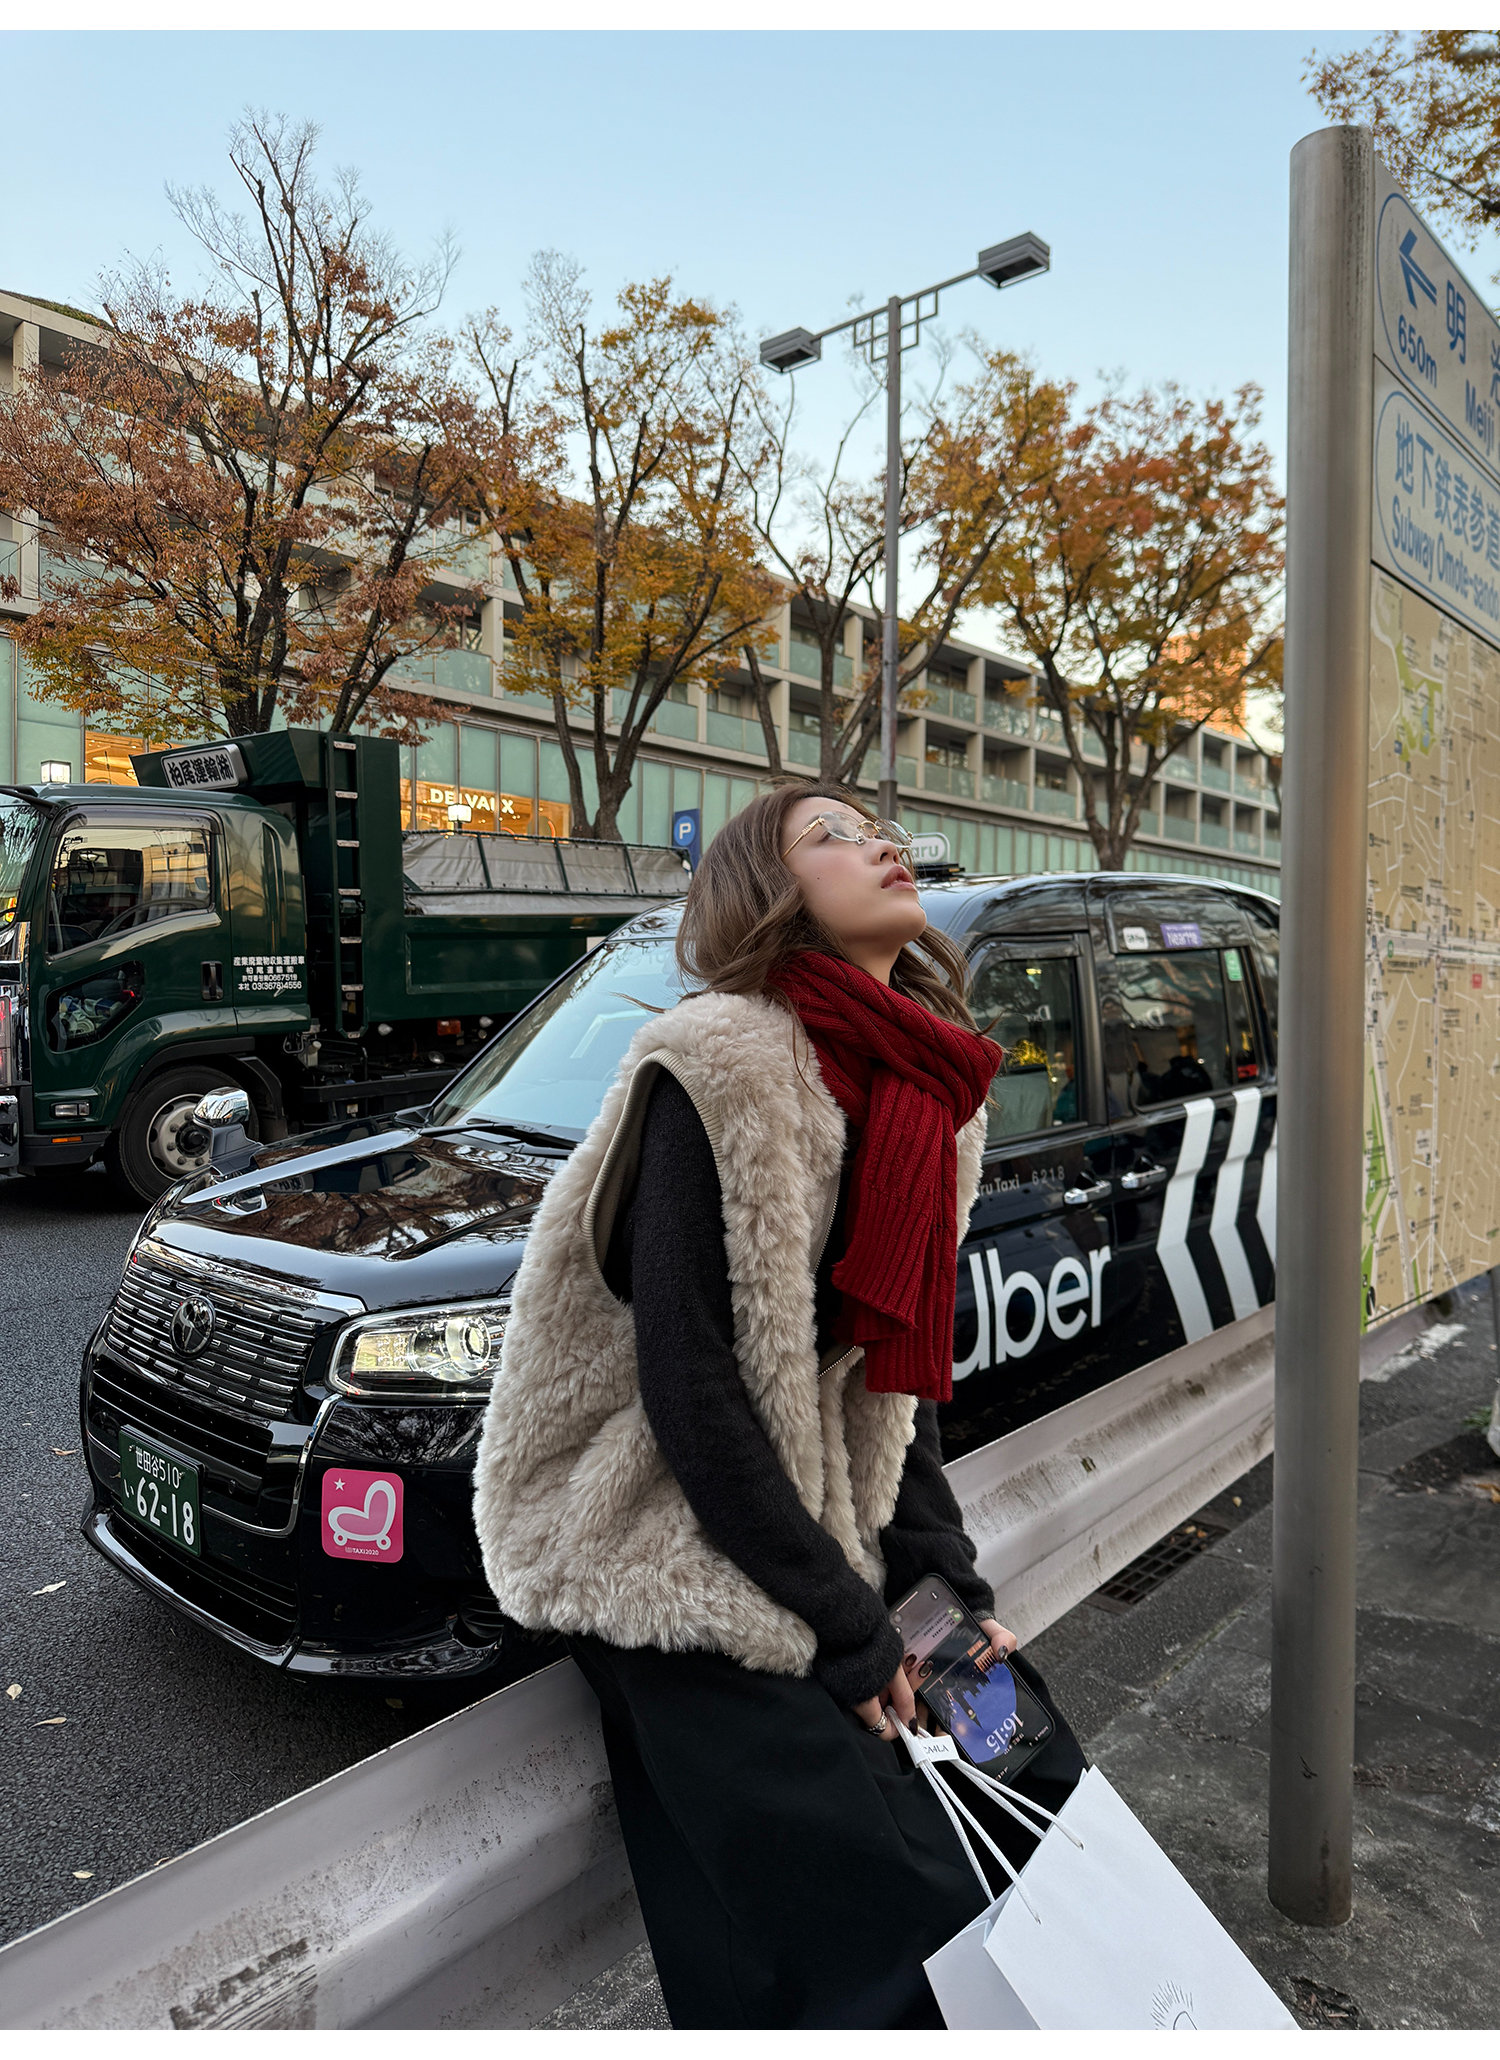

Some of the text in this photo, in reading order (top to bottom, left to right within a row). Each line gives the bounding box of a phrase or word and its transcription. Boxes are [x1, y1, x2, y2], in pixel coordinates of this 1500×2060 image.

[1398, 314, 1438, 388] 650m
[1465, 379, 1495, 457] Meiji
[1391, 494, 1434, 584] Subway
[679, 822, 692, 839] P
[1032, 1165, 1065, 1186] 6218
[137, 1476, 195, 1546] 62-18
[986, 1711, 1024, 1754] 16:15
